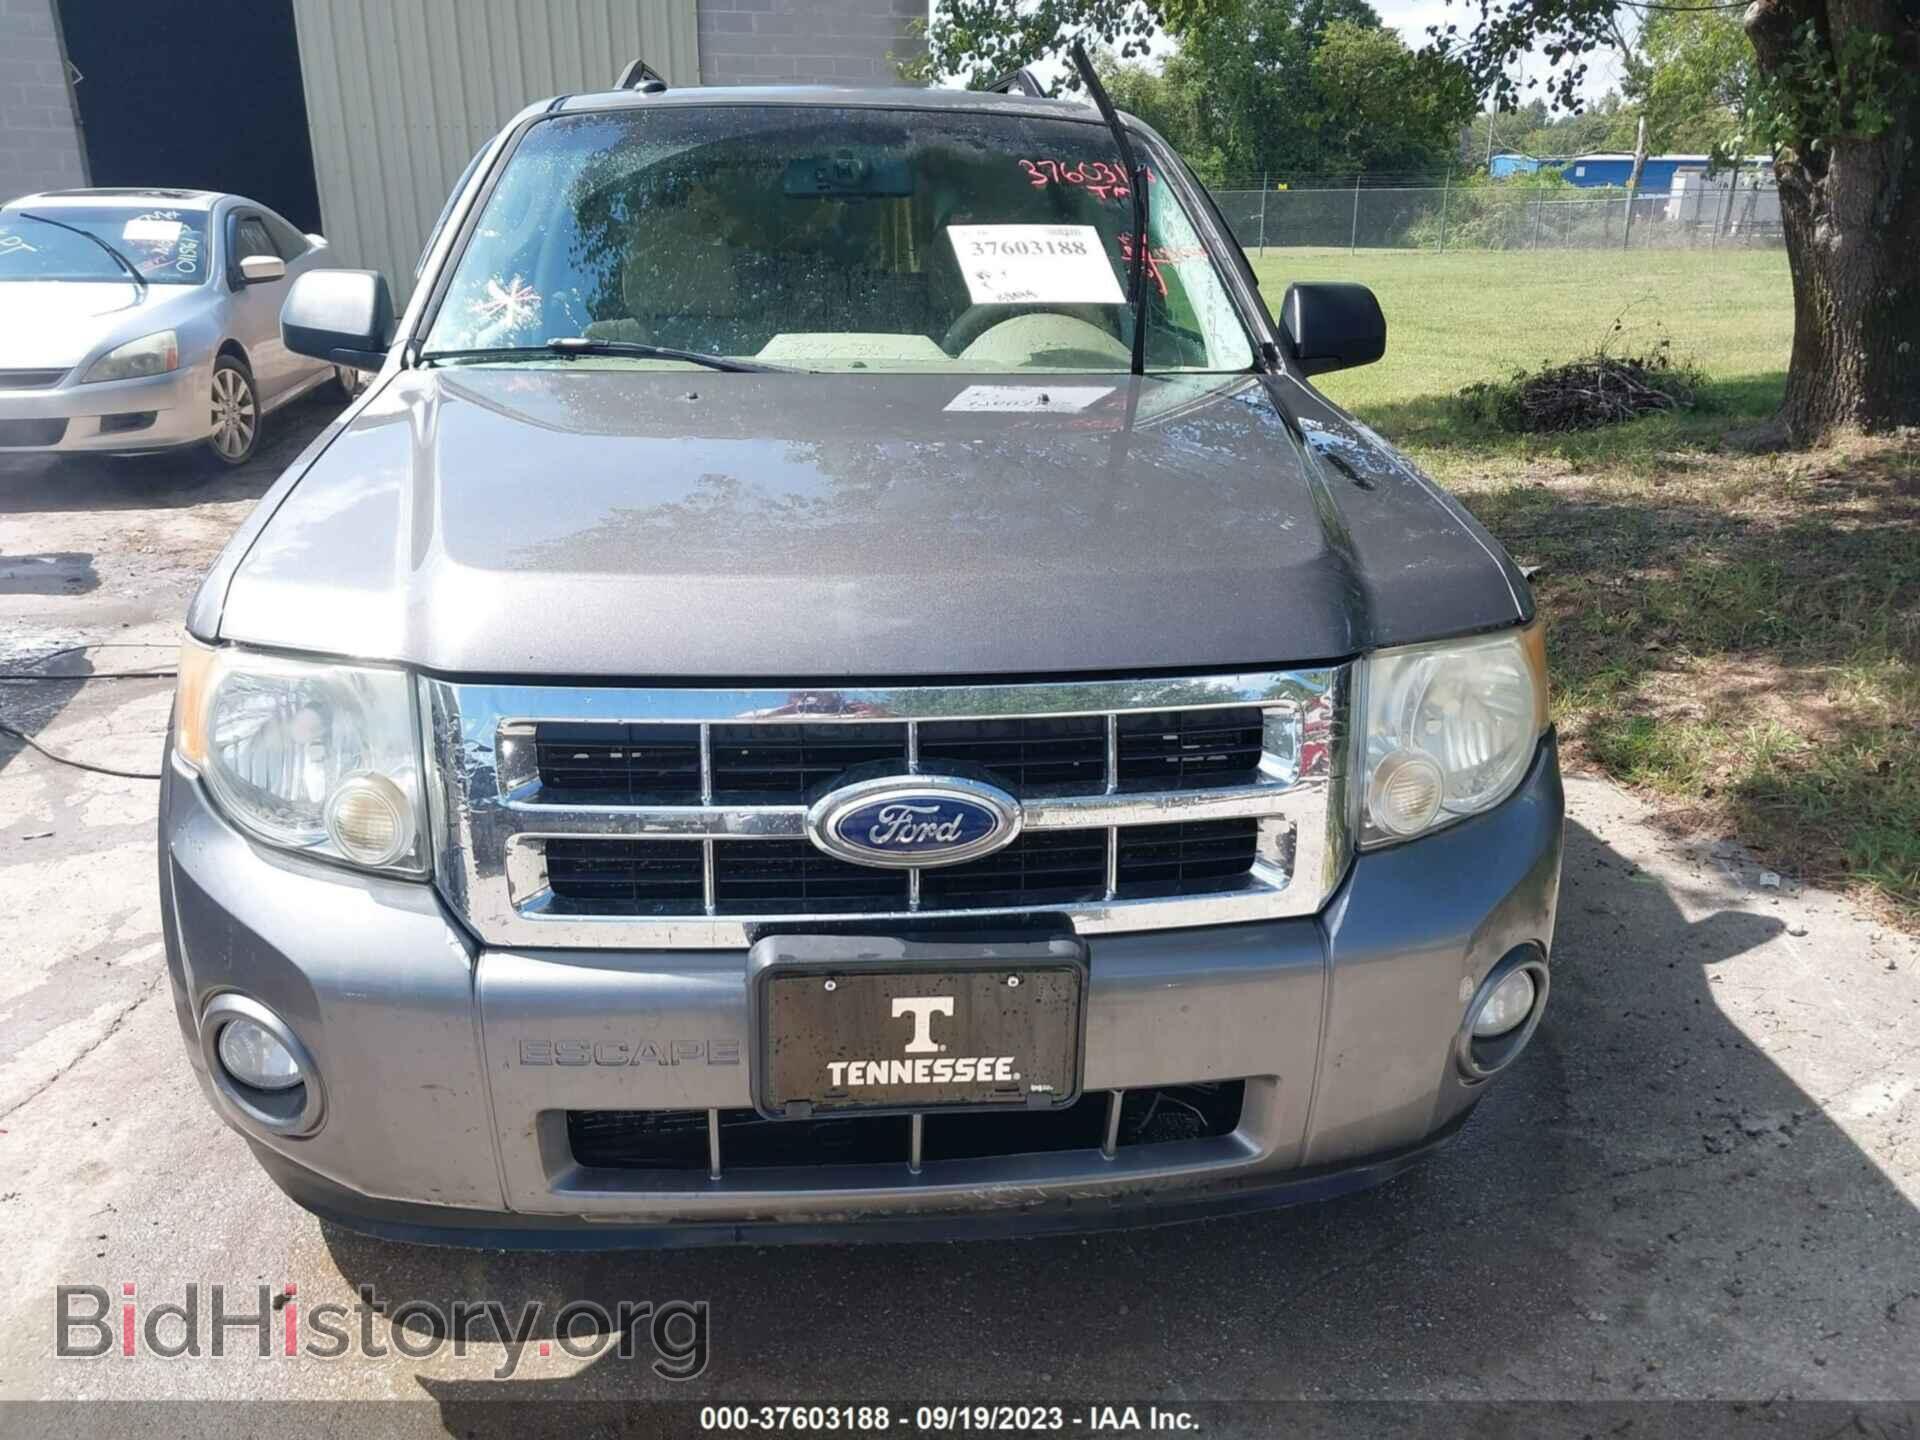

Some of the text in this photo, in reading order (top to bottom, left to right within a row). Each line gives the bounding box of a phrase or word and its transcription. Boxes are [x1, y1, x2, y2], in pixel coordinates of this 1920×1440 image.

[970, 240, 1088, 256] 37603188
[869, 804, 964, 844] Ford
[892, 996, 954, 1052] T
[519, 1039, 741, 1066] ESCAPE
[827, 1056, 1015, 1086] TENNESSEE
